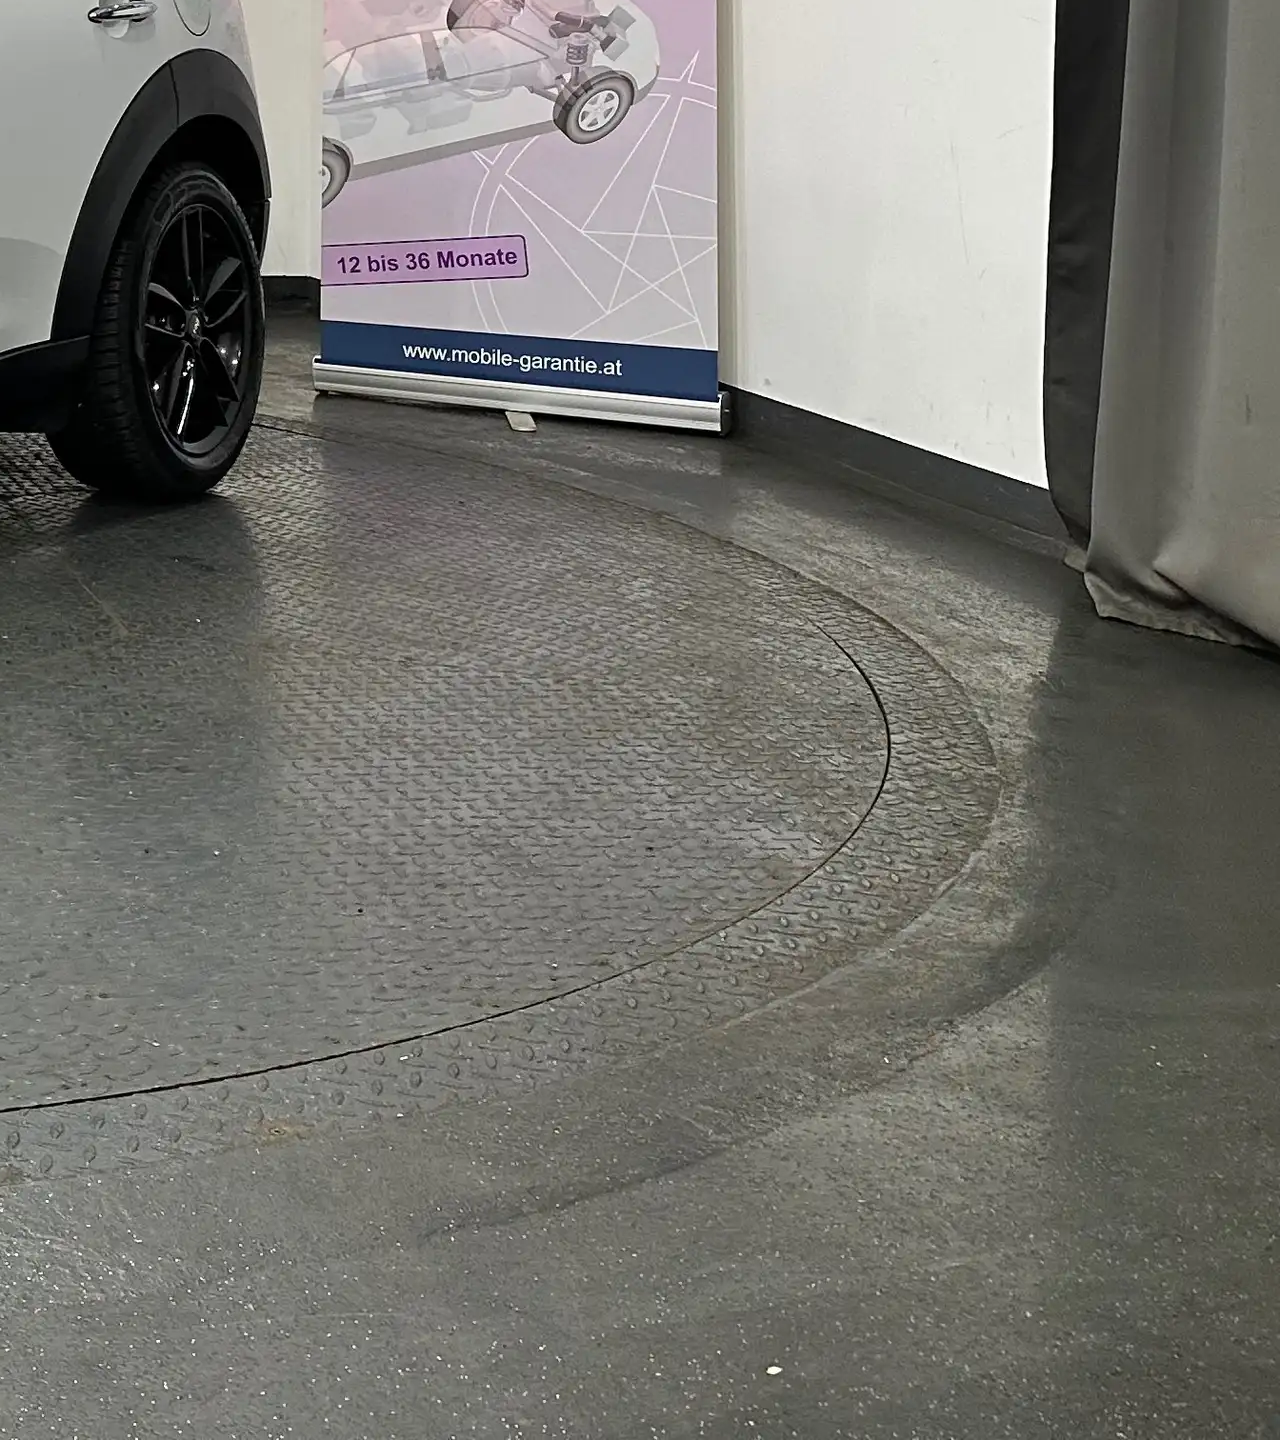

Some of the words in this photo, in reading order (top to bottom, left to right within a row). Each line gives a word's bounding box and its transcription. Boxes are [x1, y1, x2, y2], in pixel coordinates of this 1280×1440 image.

[337, 255, 361, 275] 12
[367, 252, 400, 274] bis
[404, 251, 432, 272] 36
[436, 247, 519, 271] Monate
[402, 341, 624, 377] www.mobile-garantie.at
